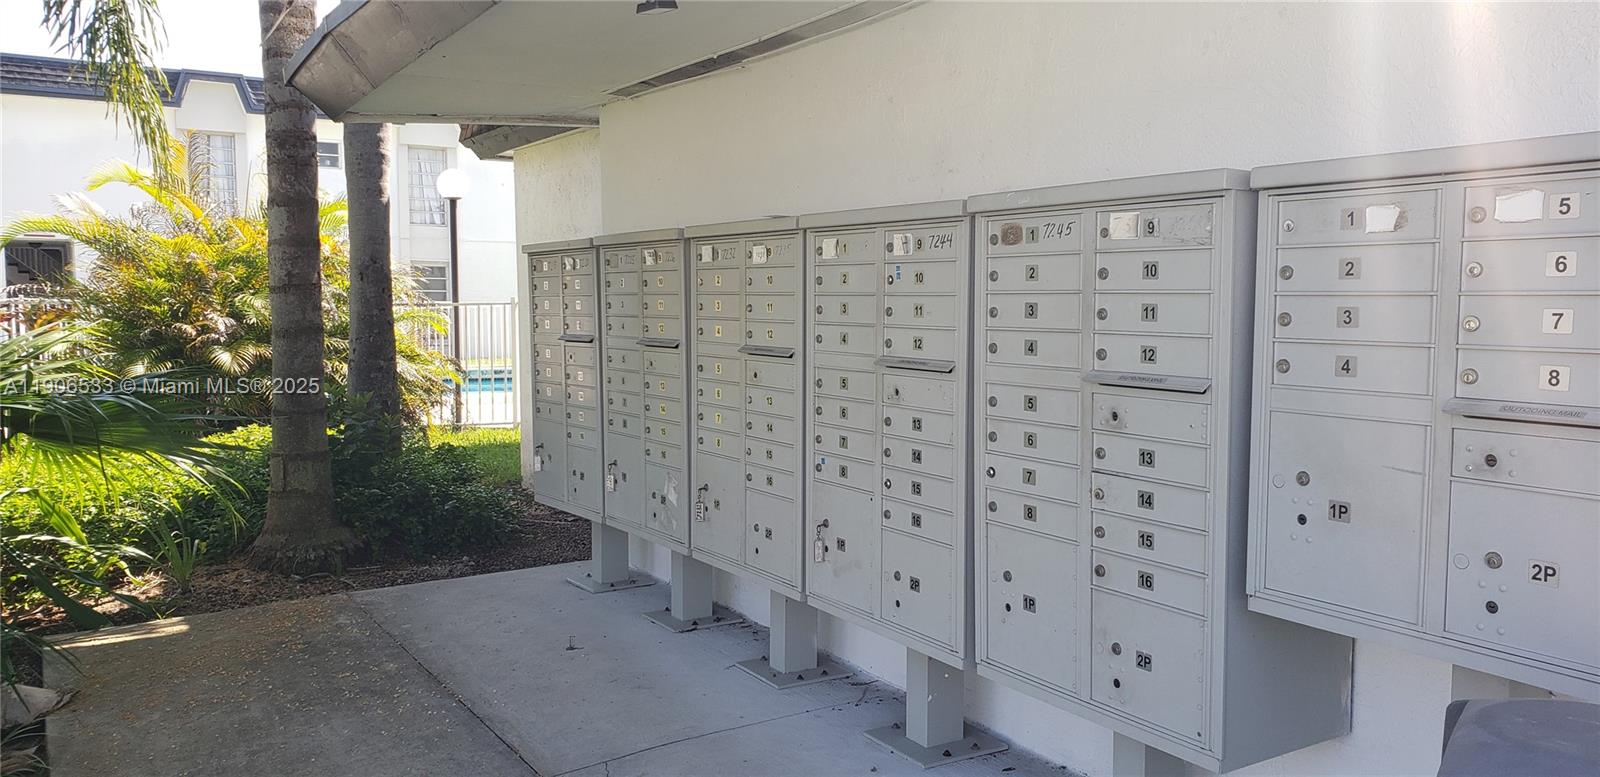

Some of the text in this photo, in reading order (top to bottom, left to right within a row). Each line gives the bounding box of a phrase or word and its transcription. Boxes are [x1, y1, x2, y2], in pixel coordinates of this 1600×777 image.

[1558, 198, 1572, 216] 5
[1346, 212, 1356, 226] 1
[1147, 222, 1154, 234] 9
[928, 232, 954, 250] 7244
[1030, 230, 1036, 241] 1
[842, 244, 847, 253] 1
[916, 239, 922, 250] 9
[1144, 264, 1158, 277] 10
[1344, 262, 1355, 276] 2
[1554, 256, 1568, 273] 6
[842, 274, 847, 284] 2
[915, 272, 924, 283] 10
[1028, 268, 1036, 279] 2
[842, 304, 847, 314] 3
[915, 306, 923, 316] 11
[1028, 305, 1035, 316] 3
[1143, 306, 1156, 320] 11
[1342, 311, 1353, 326] 3
[1551, 314, 1565, 330] 7
[842, 334, 847, 343] 4
[913, 339, 922, 350] 12
[1028, 342, 1035, 354] 4
[1142, 348, 1156, 362] 12
[1340, 360, 1352, 374] 4
[842, 379, 846, 388] 5
[1548, 370, 1561, 387] 8
[1027, 398, 1034, 410] 5
[842, 408, 846, 418] 6
[912, 420, 922, 430] 13
[841, 438, 846, 446] 7
[1027, 434, 1034, 446] 6
[912, 452, 922, 462] 14
[1140, 452, 1154, 465] 13
[841, 468, 846, 476] 8
[1026, 471, 1033, 482] 7
[912, 484, 921, 494] 15
[1140, 494, 1154, 508] 14
[1026, 508, 1034, 519] 8
[1329, 504, 1349, 520] 1P
[912, 516, 921, 526] 16
[836, 540, 846, 550] 1P
[1140, 536, 1154, 548] 15
[1531, 565, 1557, 583] 2P
[910, 580, 920, 590] 2P
[1140, 575, 1153, 588] 16
[1023, 598, 1036, 610] 1P
[1137, 655, 1152, 668] 2P
